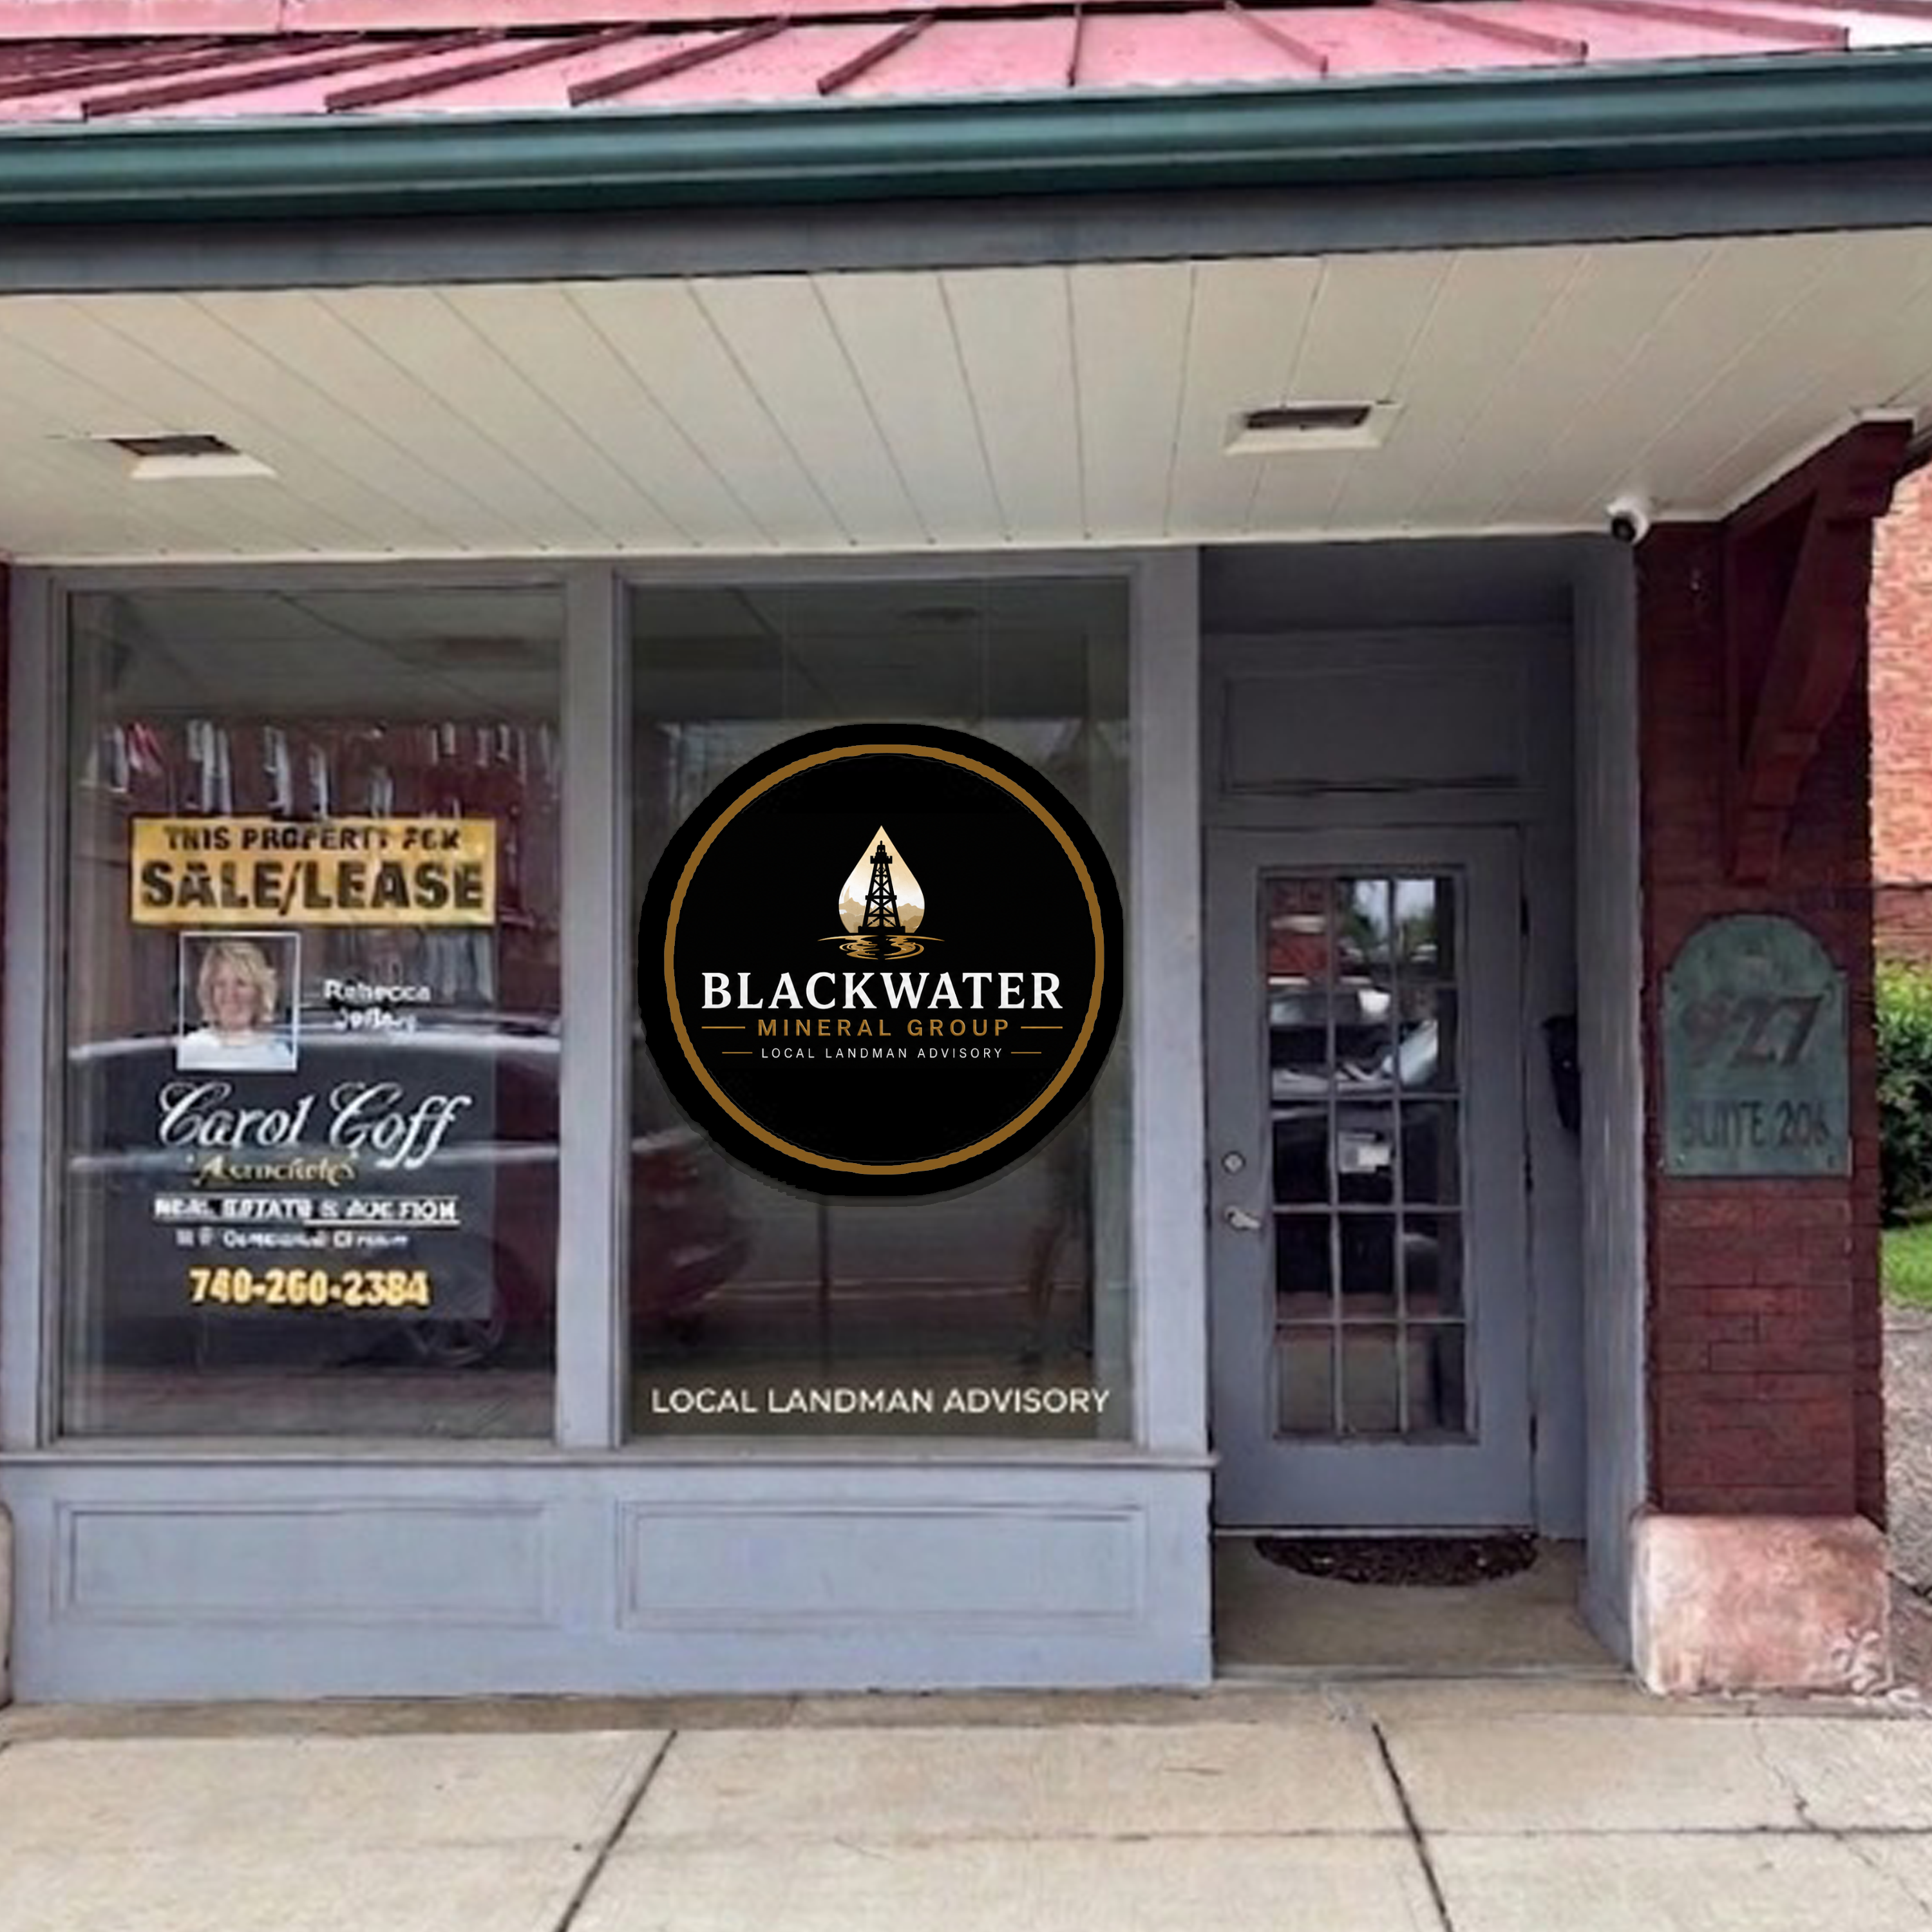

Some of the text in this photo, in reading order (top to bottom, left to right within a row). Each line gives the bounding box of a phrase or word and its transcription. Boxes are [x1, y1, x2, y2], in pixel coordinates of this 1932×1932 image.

[140, 860, 484, 915] SALE/LEASE
[702, 972, 1063, 1009] BLACKWATER
[759, 1019, 1008, 1036] MINERAL GROUP
[762, 1048, 1001, 1058] LOCAL LANDMAN ADVISORY
[158, 1081, 315, 1149] Carol
[1682, 1099, 1765, 1148] SUITE
[653, 1388, 1110, 1413] LOCAL LANDMAN ADVISORY
